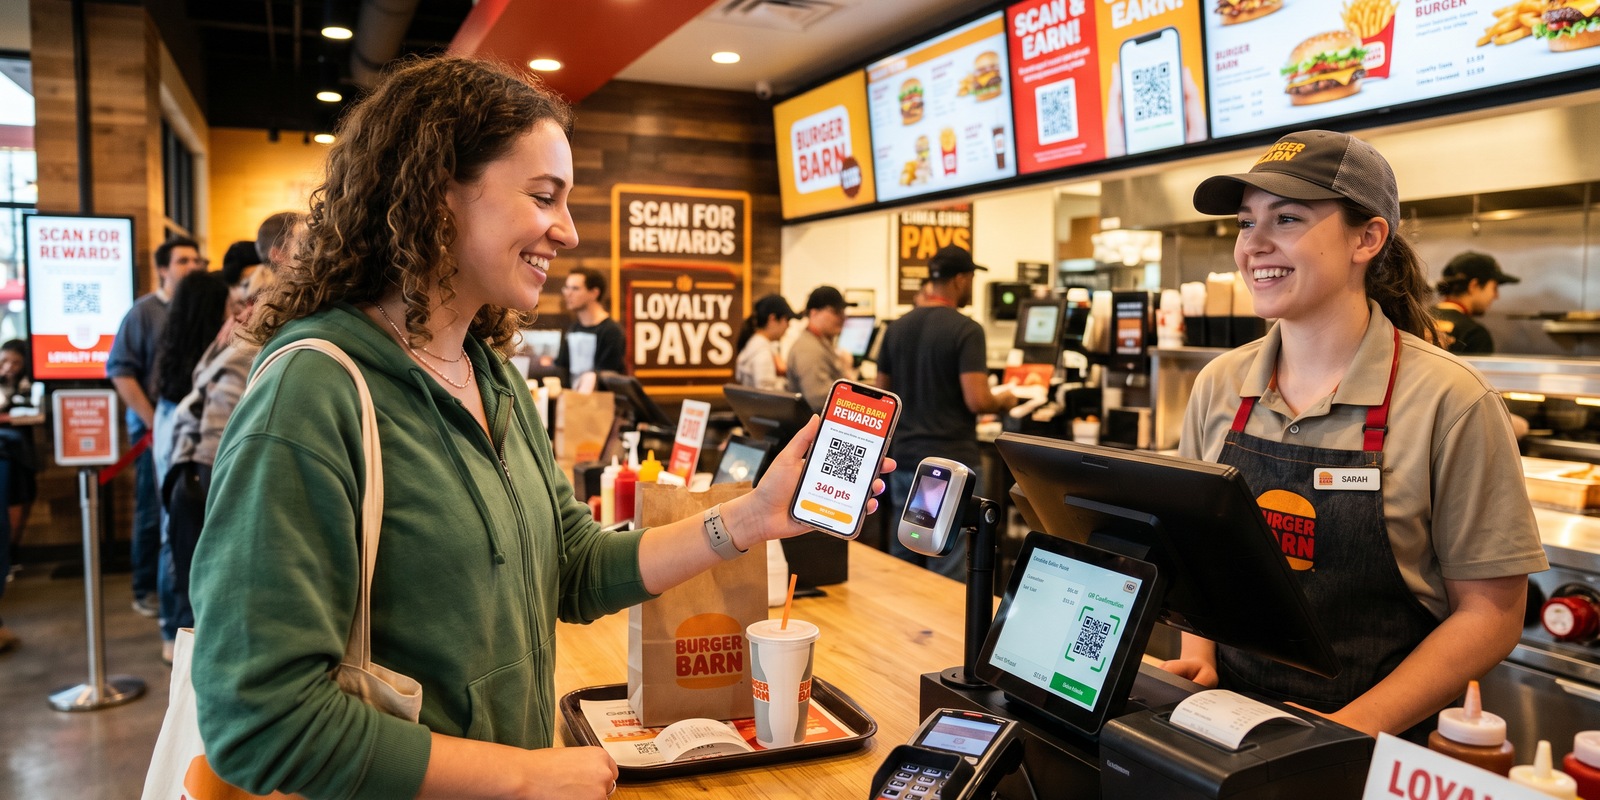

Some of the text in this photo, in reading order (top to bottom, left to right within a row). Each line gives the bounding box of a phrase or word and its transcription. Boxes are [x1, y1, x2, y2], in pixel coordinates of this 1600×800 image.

[1014, 0, 1067, 37] SCAN
[1022, 19, 1082, 60] EARN!
[1215, 44, 1250, 60] BURGER
[796, 117, 844, 151] BURGER
[799, 143, 847, 182] BARN
[628, 200, 736, 230] SCAN FOR
[39, 227, 120, 243] SCAN FOR
[628, 227, 736, 255] REWARDS
[40, 245, 121, 260] REWARDS
[634, 293, 734, 320] LOYALTY
[634, 321, 734, 366] PAYS
[833, 406, 884, 431] REWARDS
[836, 398, 888, 420] BURGER BARN
[815, 481, 834, 496] 340
[834, 489, 851, 502] pts
[1341, 475, 1368, 484] SARAH
[1262, 510, 1315, 537] URGER
[675, 634, 743, 655] BURGER
[675, 651, 743, 677] BARN
[1388, 760, 1494, 800] LOY
